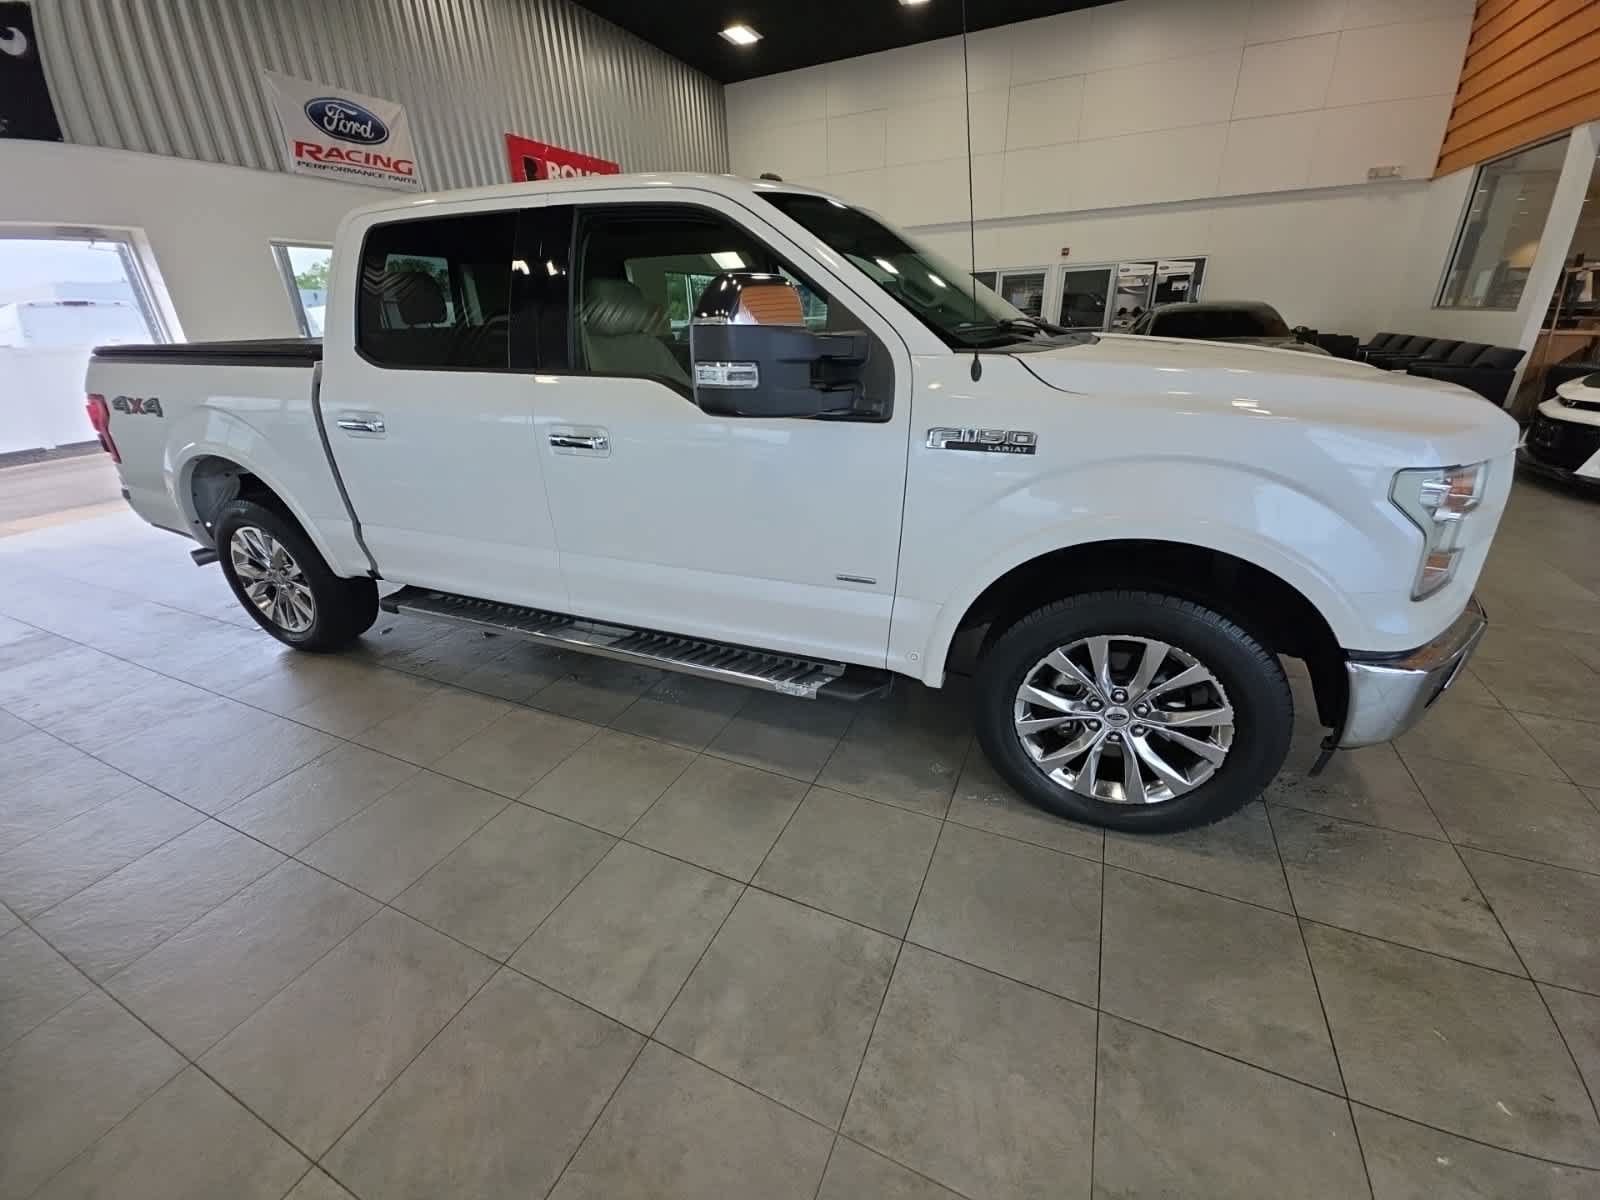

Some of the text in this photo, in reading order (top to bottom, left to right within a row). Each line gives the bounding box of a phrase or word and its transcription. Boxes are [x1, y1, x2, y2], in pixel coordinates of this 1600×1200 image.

[324, 103, 374, 138] Ford
[295, 141, 413, 176] RACING
[297, 160, 417, 185] PERFORMANCE PARTS
[987, 445, 1029, 454] LARIAT
